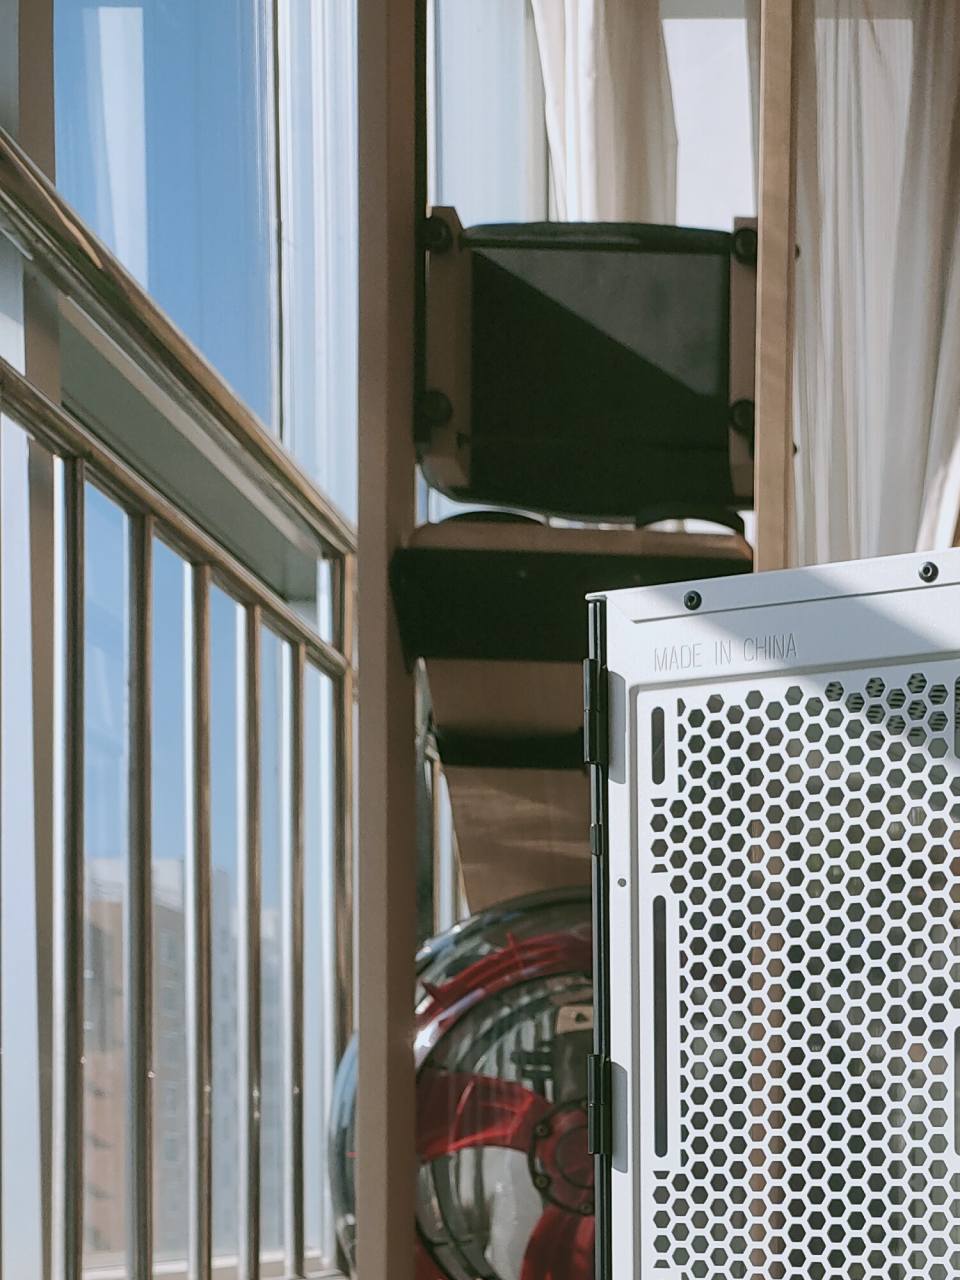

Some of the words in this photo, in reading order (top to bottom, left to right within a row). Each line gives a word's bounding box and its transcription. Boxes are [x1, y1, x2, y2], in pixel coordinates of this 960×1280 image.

[654, 642, 703, 673] MADE
[714, 639, 732, 665] IN
[743, 632, 797, 662] CHINA
